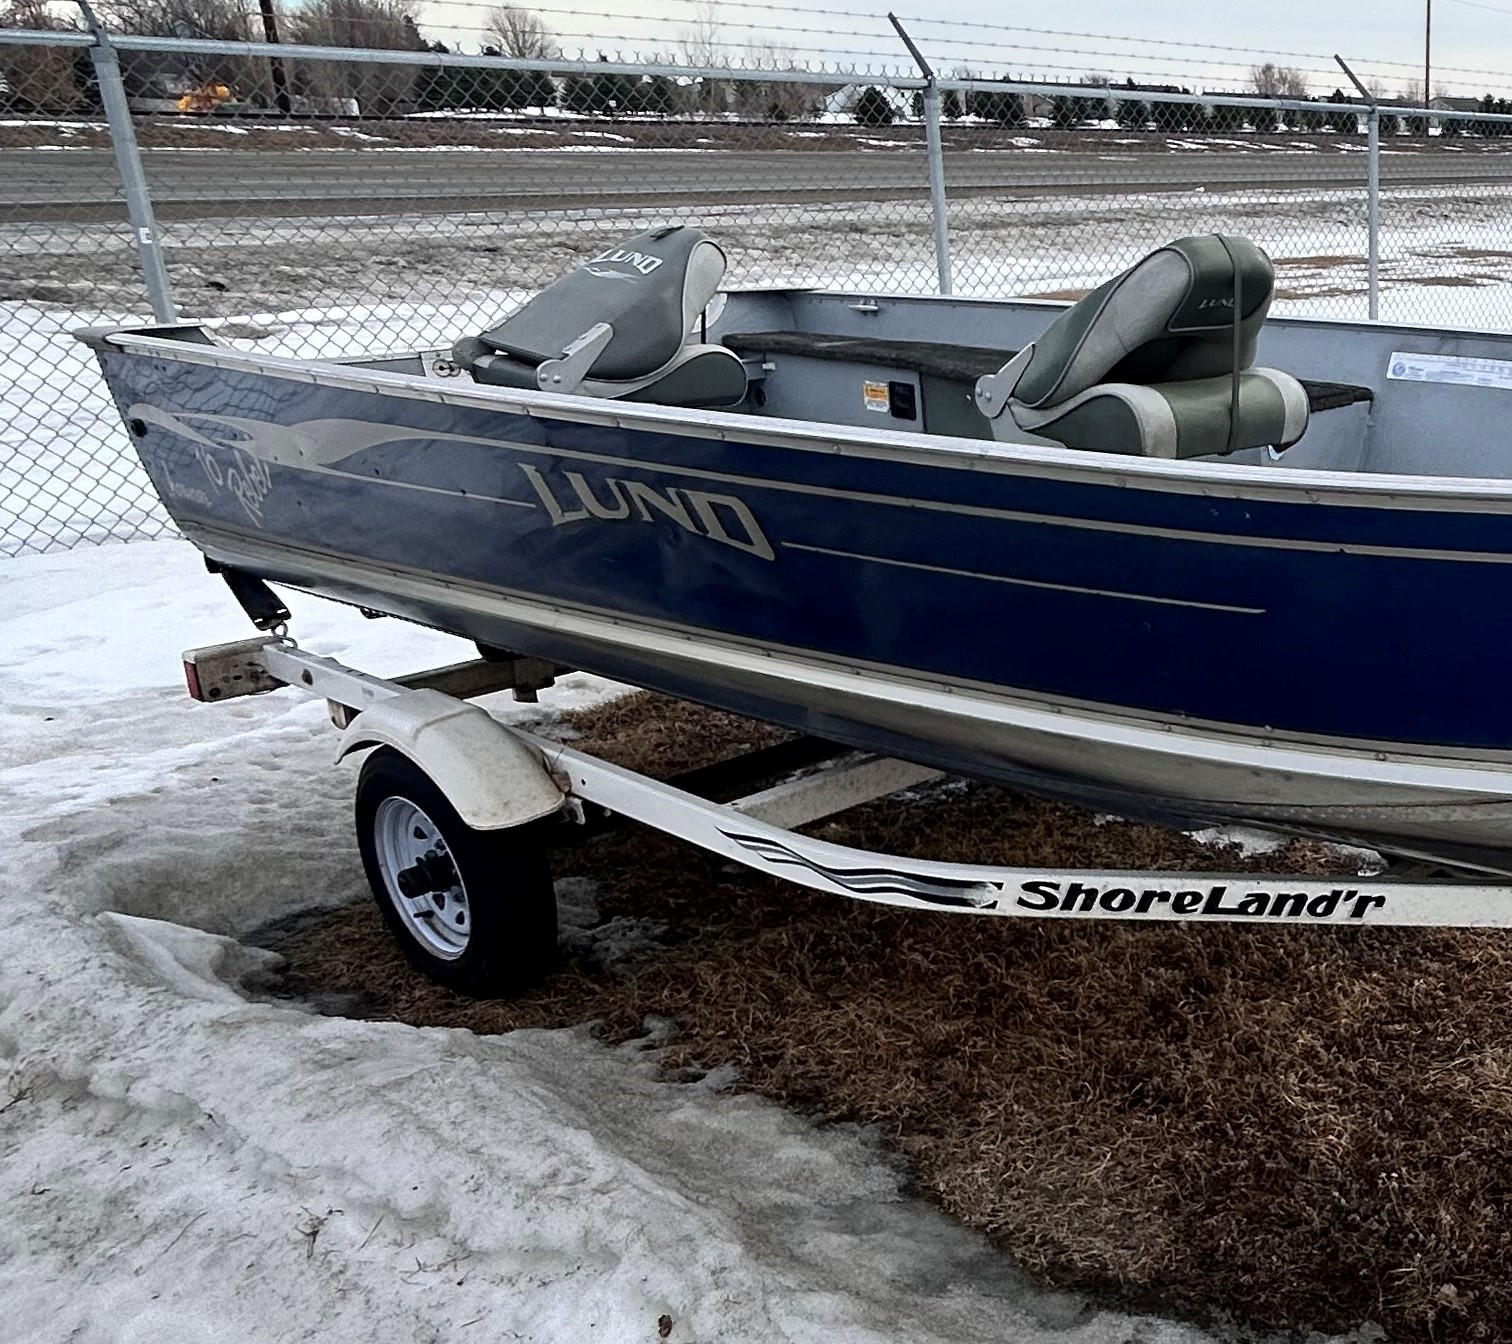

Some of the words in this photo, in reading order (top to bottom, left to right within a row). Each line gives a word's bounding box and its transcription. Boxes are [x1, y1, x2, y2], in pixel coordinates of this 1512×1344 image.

[588, 248, 664, 276] LUND
[517, 462, 776, 562] LUND
[1016, 879, 1388, 919] ShoreLand'r
